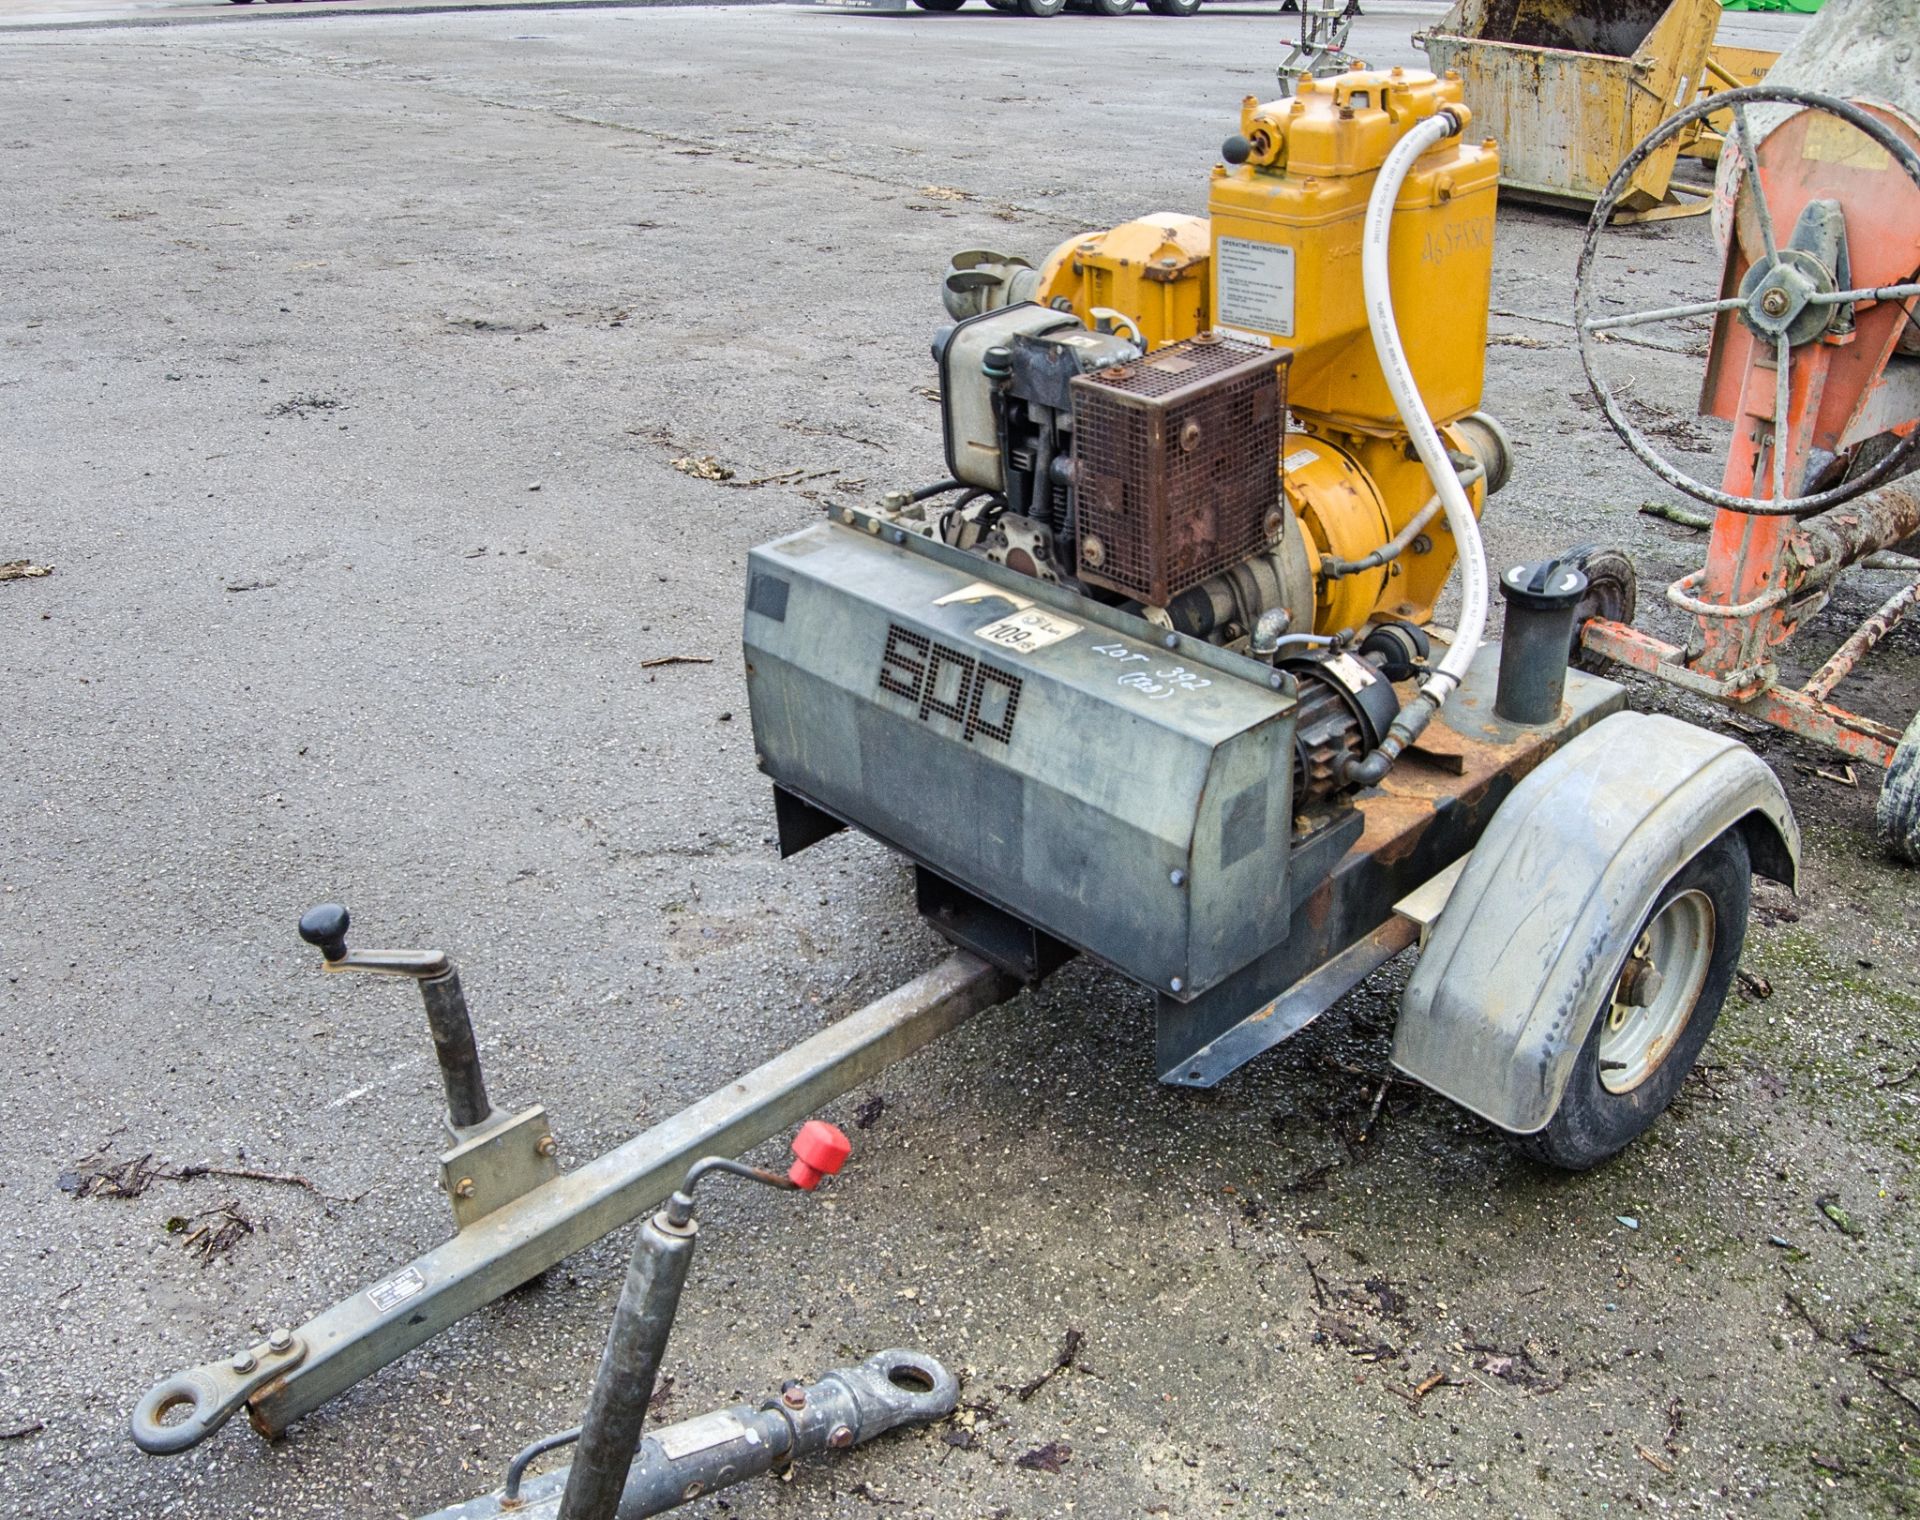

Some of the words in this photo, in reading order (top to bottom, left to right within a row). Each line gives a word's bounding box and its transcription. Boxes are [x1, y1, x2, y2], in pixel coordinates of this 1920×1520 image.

[1221, 240, 1250, 249] OPERATING
[1251, 244, 1289, 255] INSTRUCTIONS
[988, 623, 1033, 643] 109
[1091, 643, 1150, 662] LOT
[1156, 667, 1212, 691] 392
